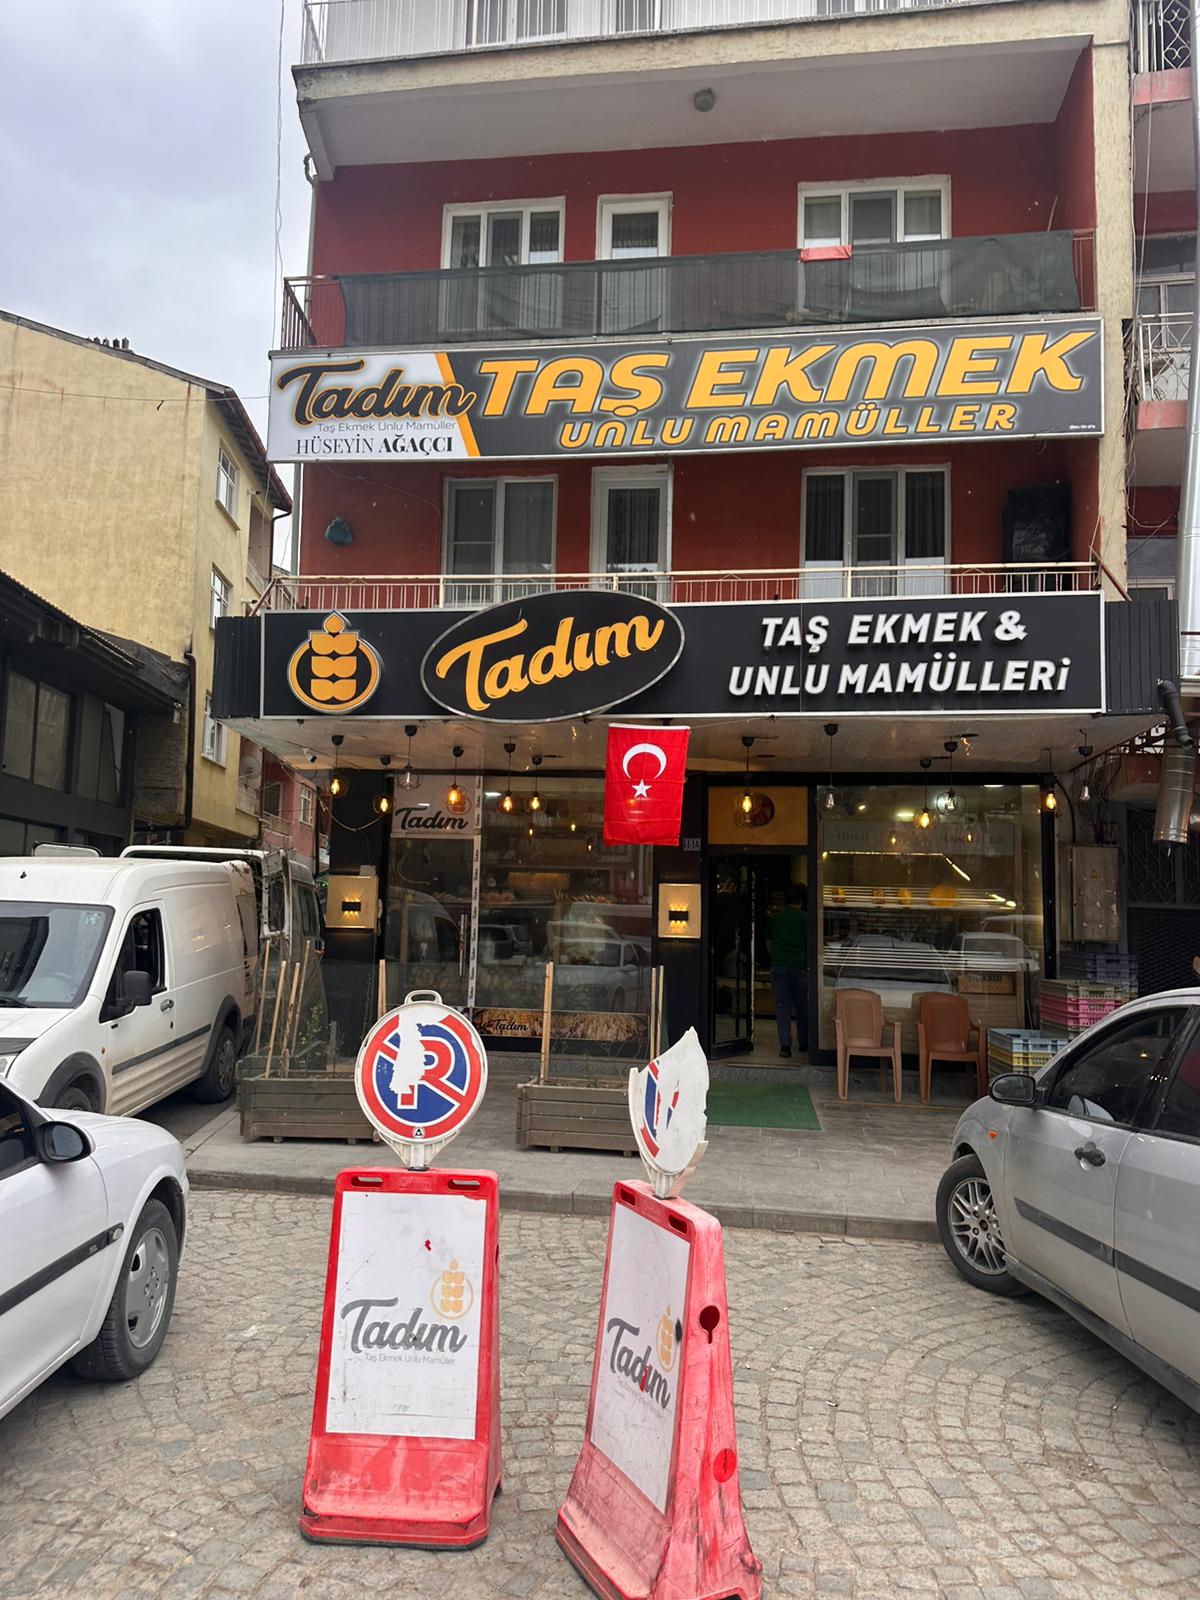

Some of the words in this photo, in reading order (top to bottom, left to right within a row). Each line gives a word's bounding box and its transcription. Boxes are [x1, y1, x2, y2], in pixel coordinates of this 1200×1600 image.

[277, 359, 476, 425] Tadım
[478, 353, 671, 417] TAŞ
[685, 331, 1098, 409] EKMEK
[296, 434, 374, 455] HÜSEYİN
[378, 433, 453, 455] AĞAÇCI
[319, 423, 335, 434] Taş
[339, 422, 375, 432] Ekmek
[761, 615, 830, 653] TAŞ
[847, 610, 988, 645] EKMEK
[994, 610, 1028, 642] &
[435, 615, 665, 712] Tadım
[728, 664, 830, 696] UNLU
[394, 806, 469, 830] Tadım
[340, 1297, 468, 1353] Tadım
